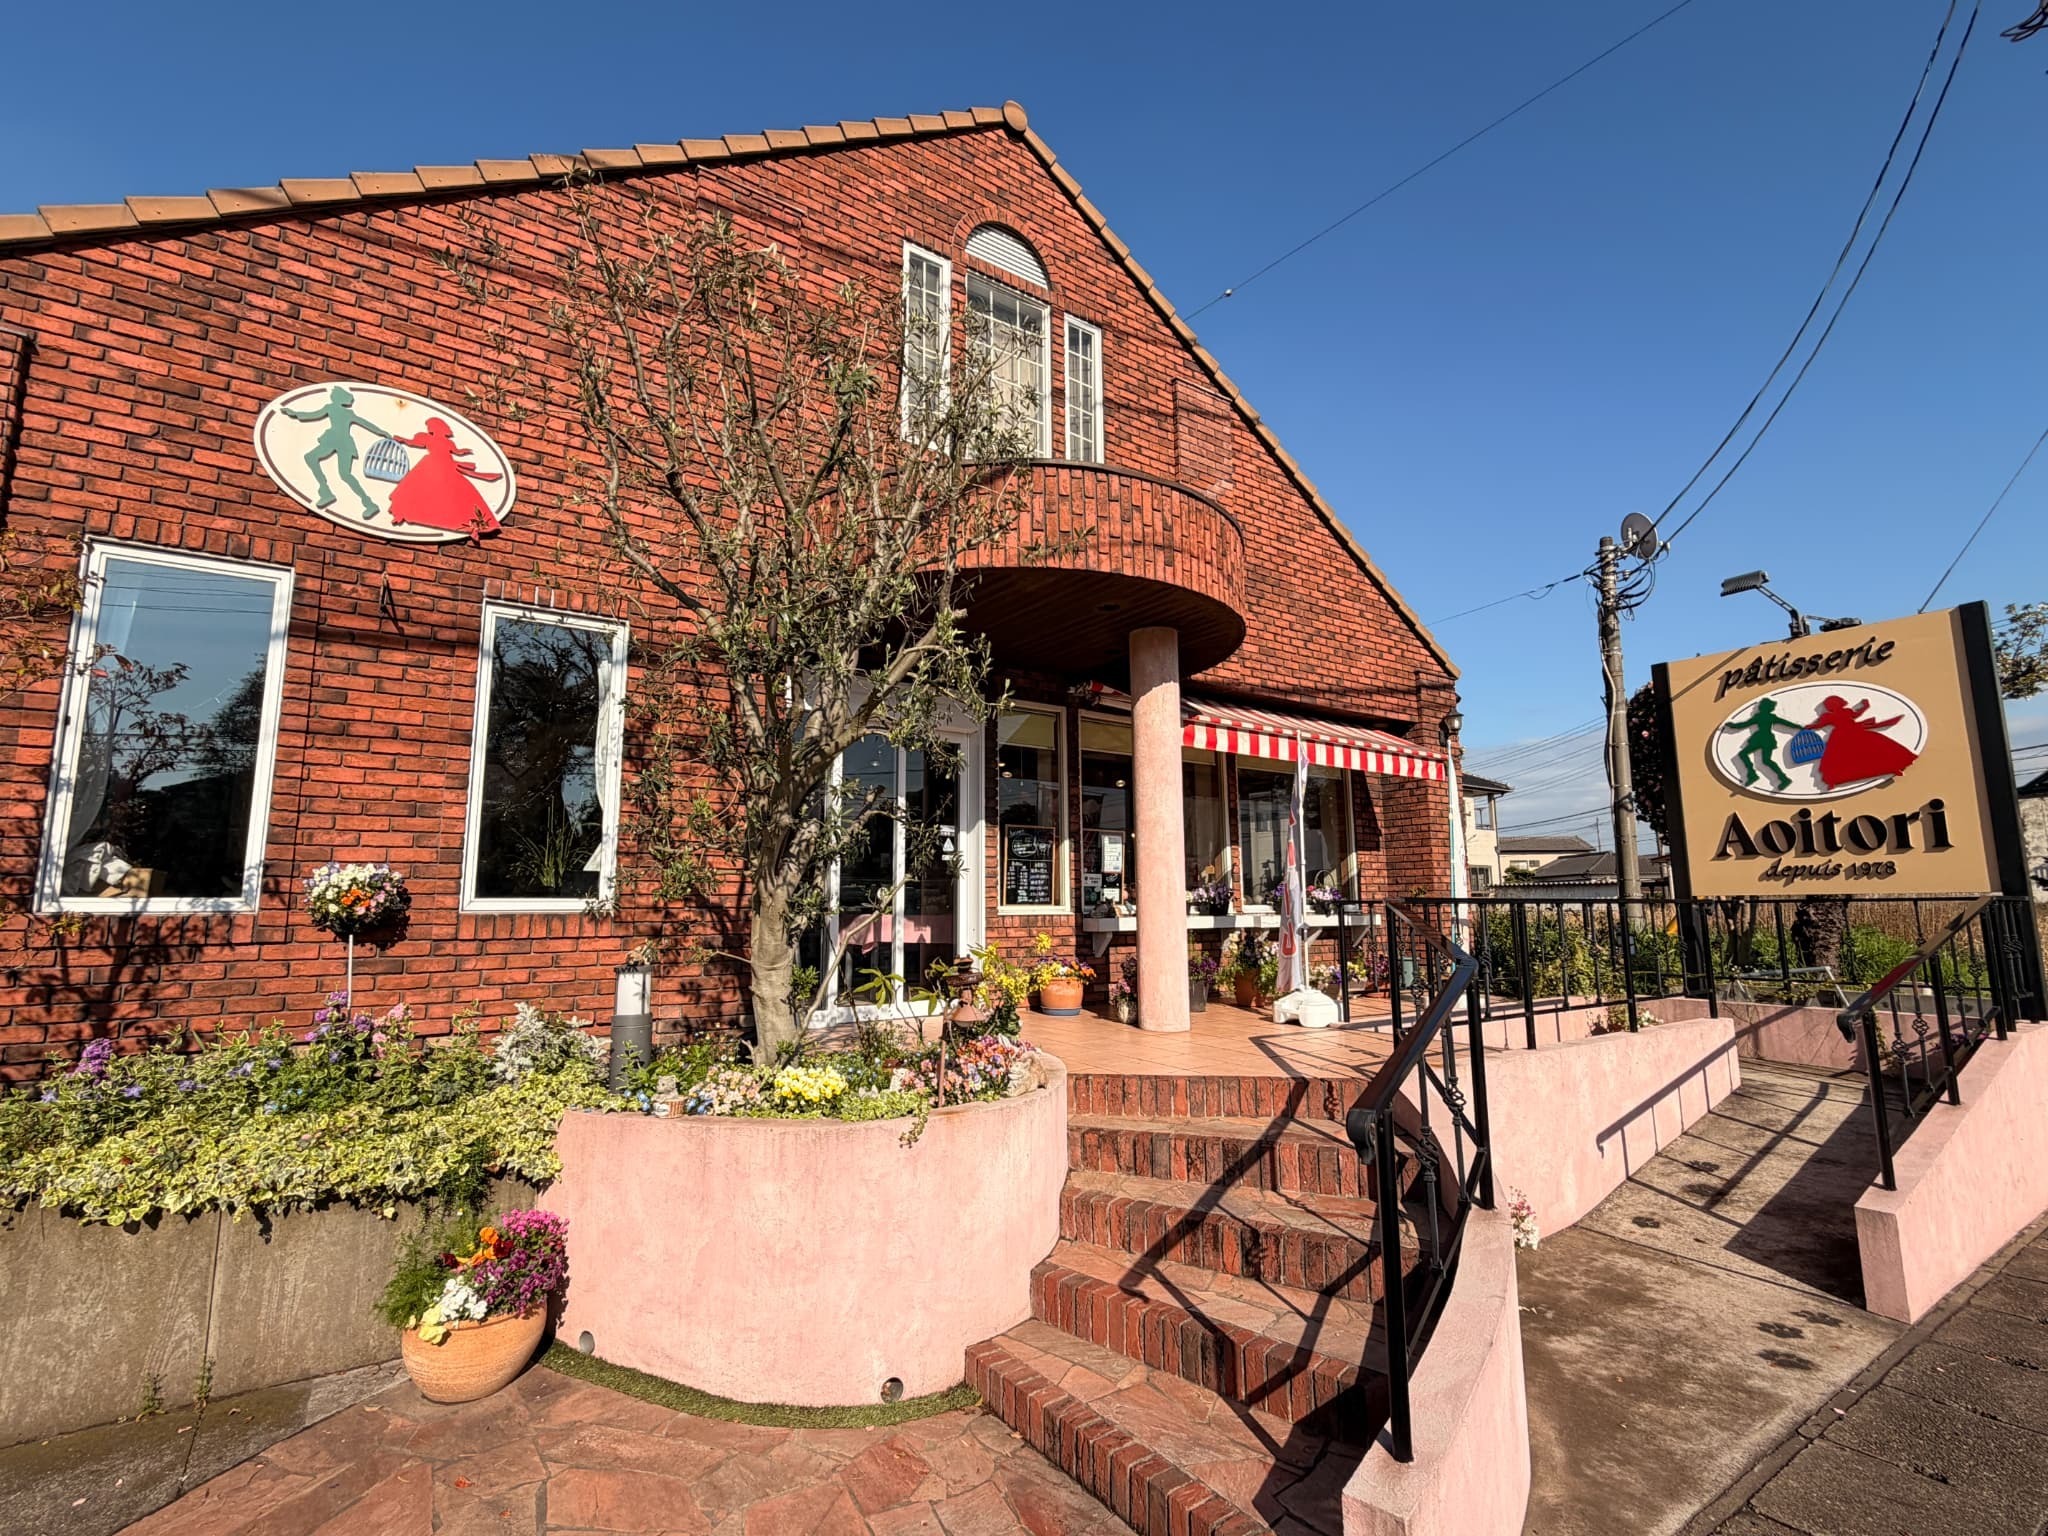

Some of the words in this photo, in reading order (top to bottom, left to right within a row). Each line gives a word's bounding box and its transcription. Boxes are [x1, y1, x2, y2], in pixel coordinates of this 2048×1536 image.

[1719, 636, 1896, 700] pâtisserie
[1716, 798, 1955, 858] Aoitori
[1765, 858, 1842, 884] depuis
[1850, 860, 1897, 877] 1978
